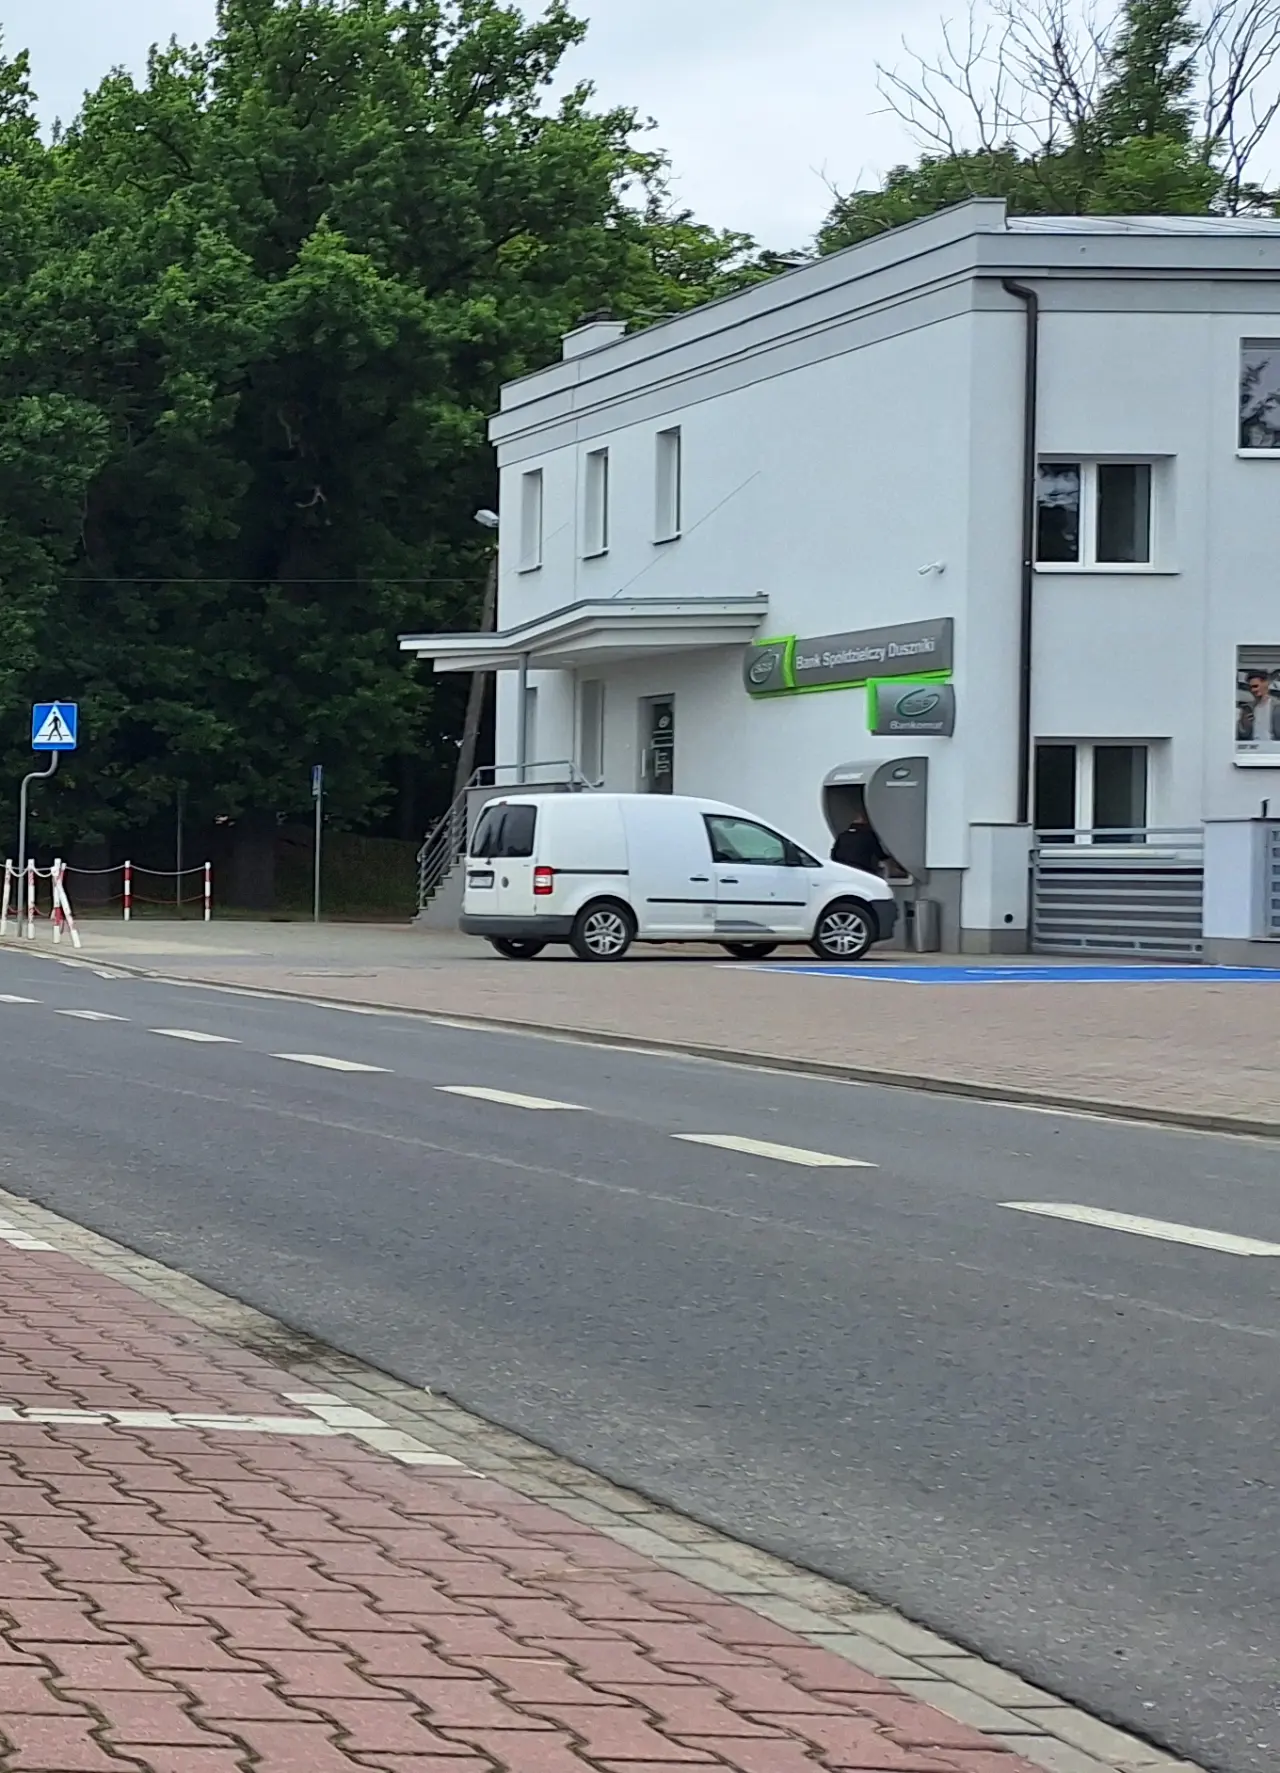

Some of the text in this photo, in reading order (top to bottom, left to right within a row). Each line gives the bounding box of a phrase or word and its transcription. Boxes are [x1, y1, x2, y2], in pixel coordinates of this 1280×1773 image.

[796, 655, 822, 670] Bank
[888, 637, 936, 658] Duszniki
[890, 720, 944, 730] Bankomat
